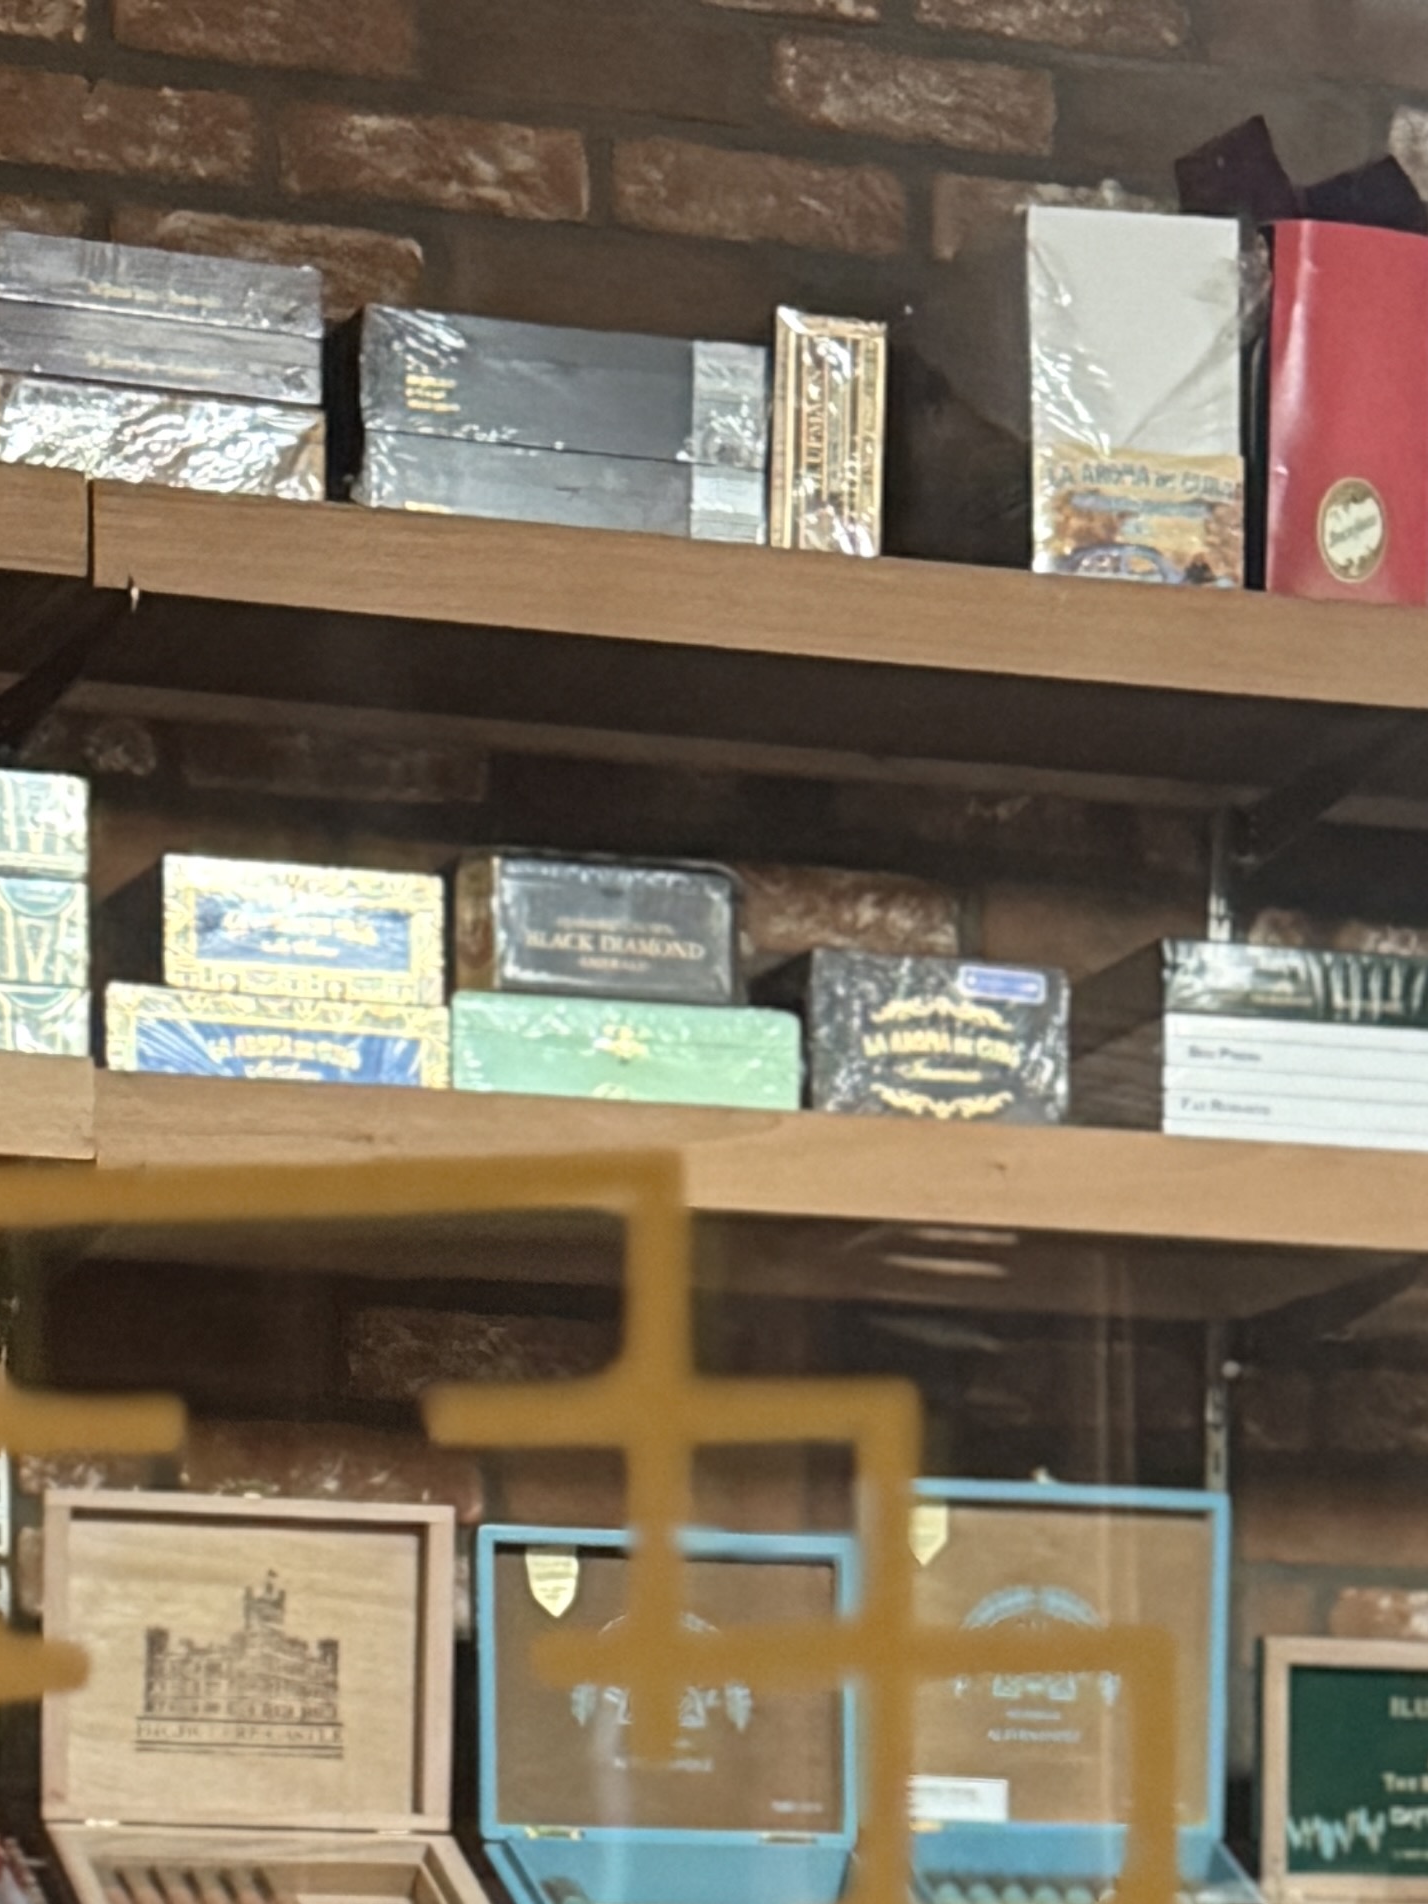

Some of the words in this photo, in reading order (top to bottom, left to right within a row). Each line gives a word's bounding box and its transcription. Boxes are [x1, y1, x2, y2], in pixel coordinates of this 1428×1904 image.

[1081, 464, 1150, 488] AROMA
[524, 929, 594, 953] BLACK
[598, 935, 707, 961] DIAMOND
